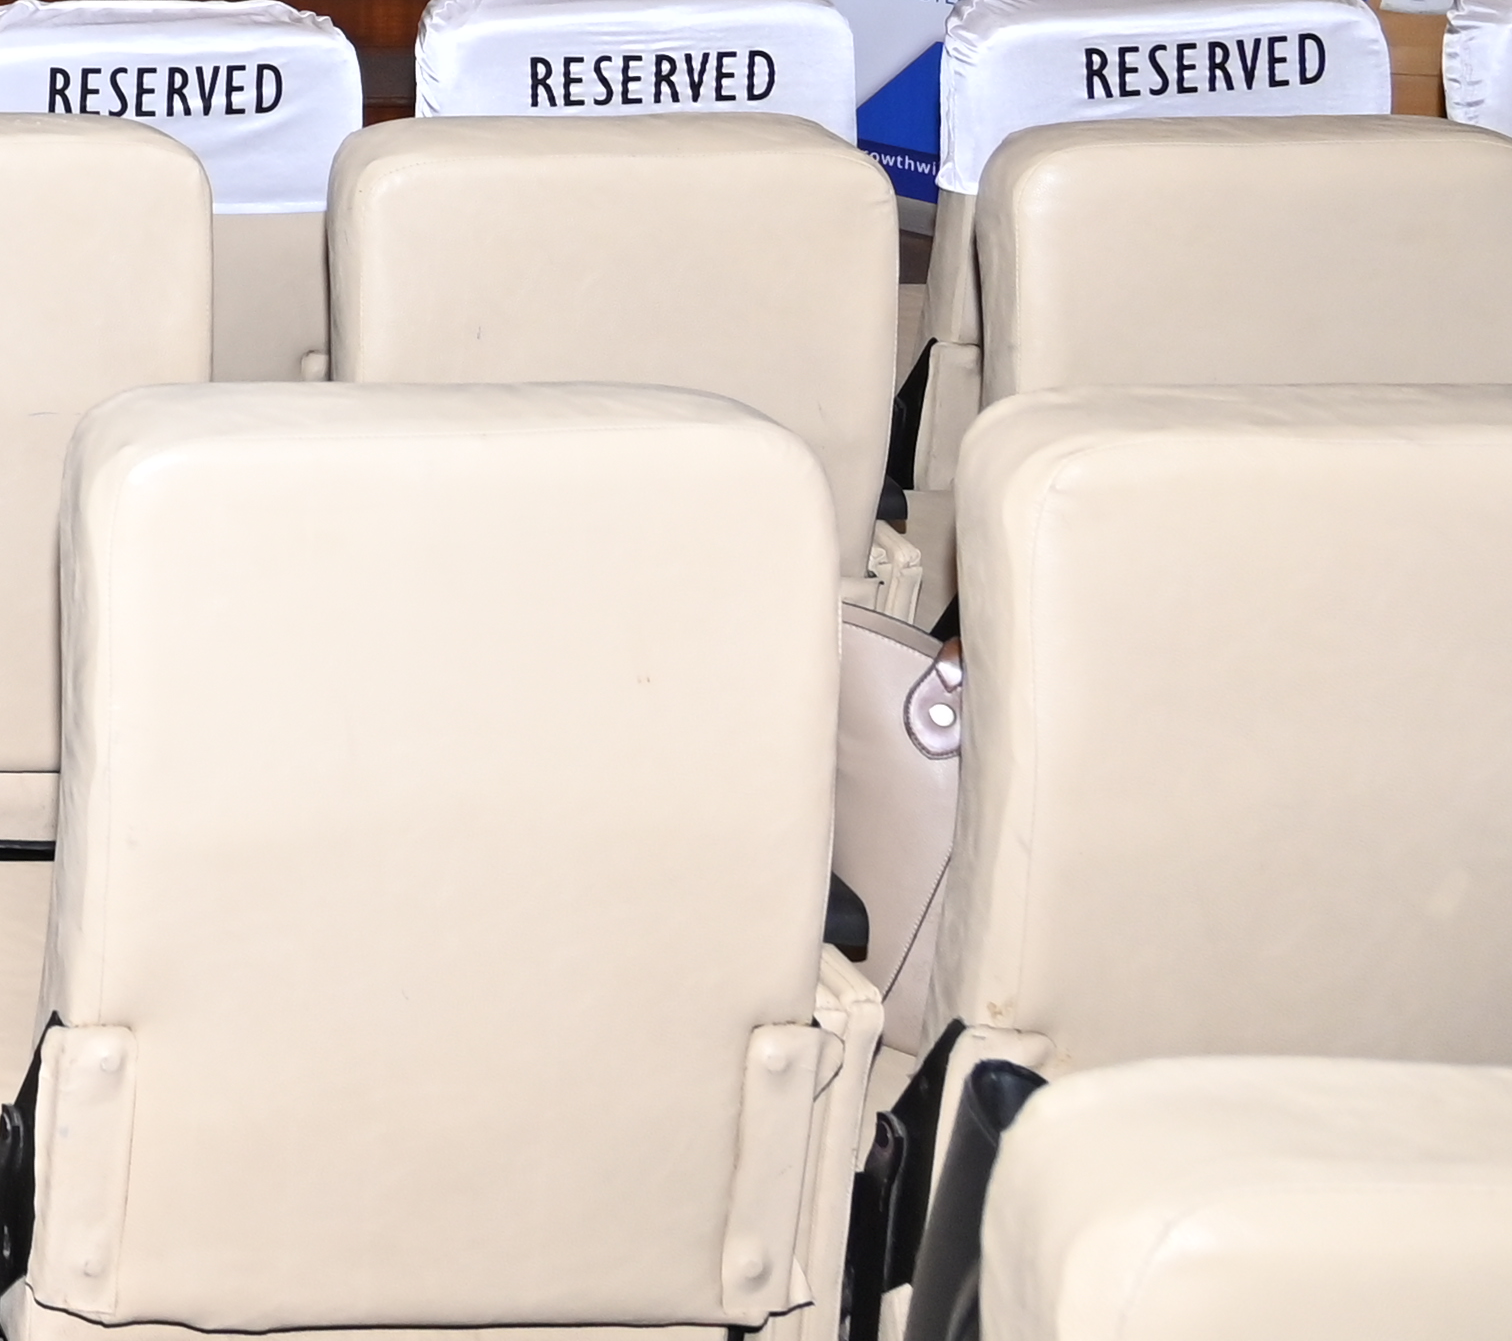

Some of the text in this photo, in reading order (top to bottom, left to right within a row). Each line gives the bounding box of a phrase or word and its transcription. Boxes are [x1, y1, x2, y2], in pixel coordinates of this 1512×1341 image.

[48, 64, 283, 117] RESERVED
[529, 50, 776, 107] RESERVED
[1084, 33, 1326, 99] RESERVED
